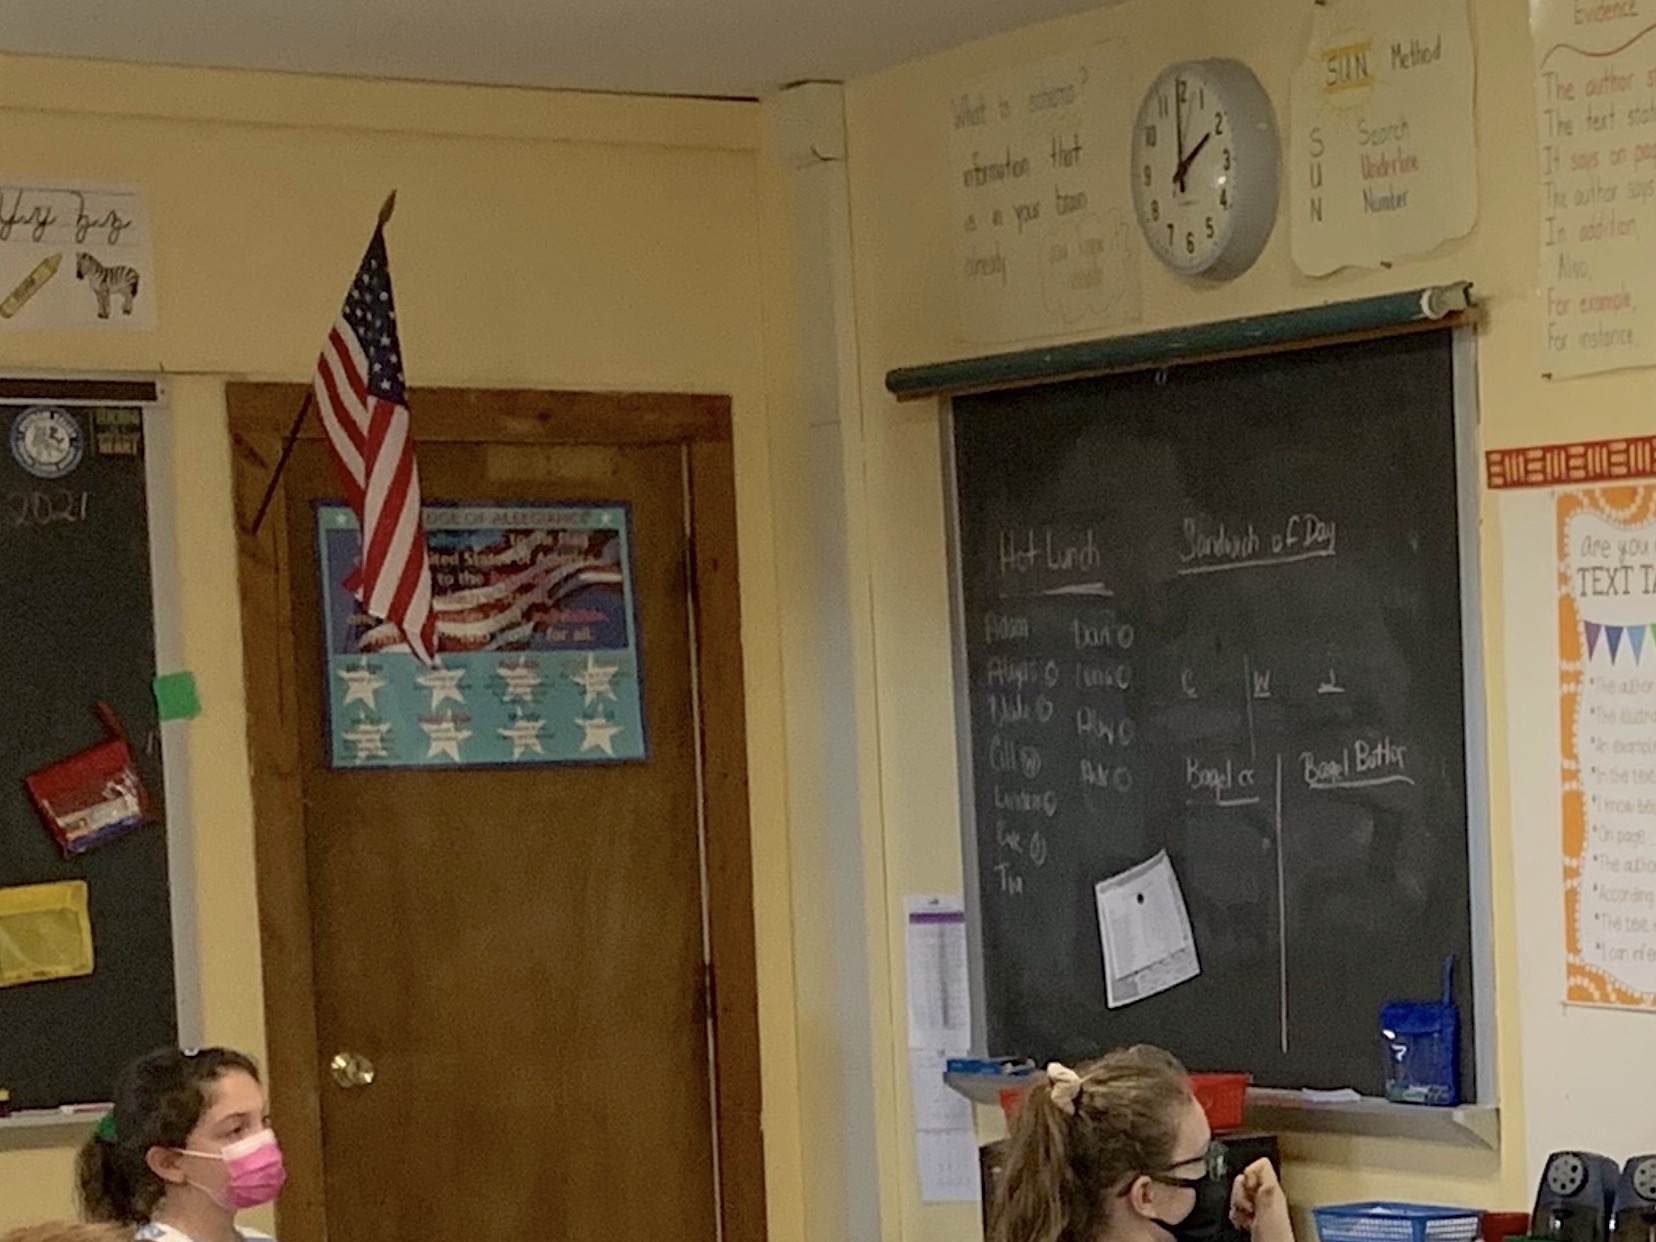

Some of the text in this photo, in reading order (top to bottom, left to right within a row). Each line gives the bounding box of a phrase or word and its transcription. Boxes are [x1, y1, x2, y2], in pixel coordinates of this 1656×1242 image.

[1326, 32, 1442, 86] SUN Method
[1543, 71, 1574, 101] The
[1585, 69, 1634, 97] author
[1158, 95, 1168, 118] 11
[1215, 111, 1223, 135] 2
[1309, 117, 1410, 158] S Search
[1544, 109, 1573, 137] The
[1587, 111, 1616, 131] text
[1051, 133, 1082, 168] that
[1222, 148, 1231, 171] 3
[1571, 149, 1600, 172] says
[1610, 146, 1627, 166] on
[1144, 164, 1152, 187] 9
[1309, 145, 1419, 189] U Underline
[1220, 188, 1228, 207] 4
[1310, 183, 1409, 223] N Number
[1544, 181, 1566, 209] The
[1574, 180, 1618, 204] author
[1627, 178, 1655, 205] says
[1151, 199, 1160, 222] 8
[1166, 223, 1175, 247] 7
[1205, 216, 1214, 239] 5
[1545, 216, 1566, 246] In
[1186, 231, 1195, 254] 6
[1272, 515, 1299, 553] of
[1303, 514, 1336, 552] Day
[1000, 528, 1100, 574] Hot Lunch
[1618, 540, 1650, 563] you
[1577, 566, 1635, 597] TEXT
[1254, 669, 1270, 690] W
[1186, 757, 1231, 797] Bagel
[1301, 748, 1349, 783] Bagel
